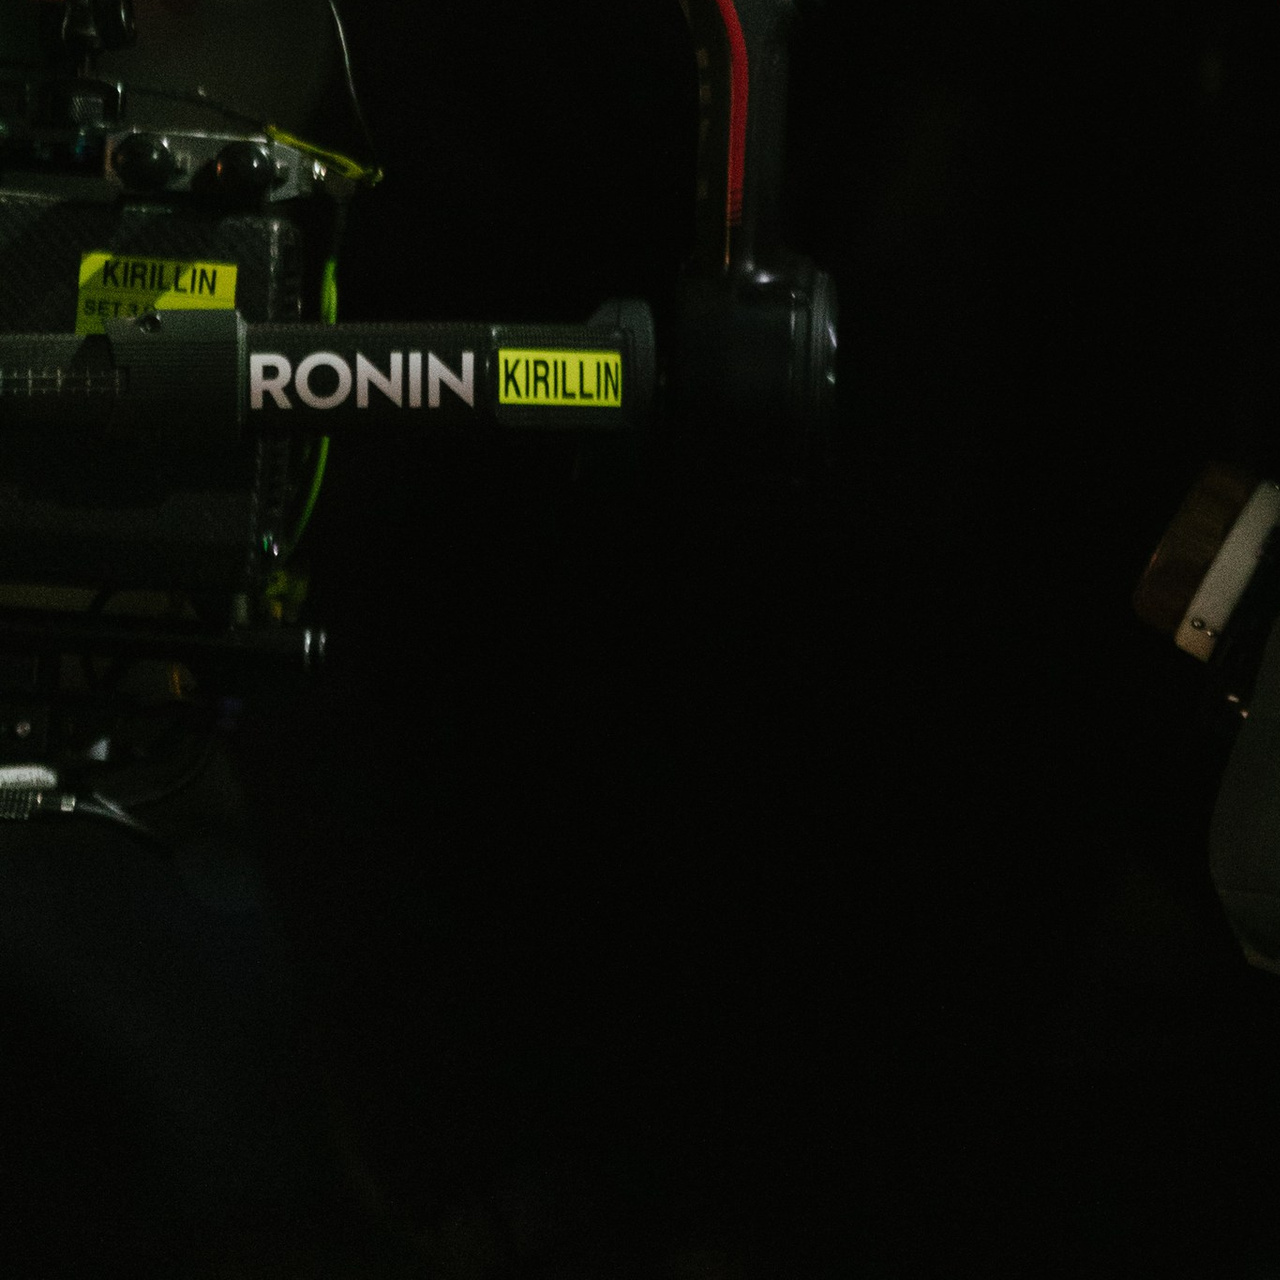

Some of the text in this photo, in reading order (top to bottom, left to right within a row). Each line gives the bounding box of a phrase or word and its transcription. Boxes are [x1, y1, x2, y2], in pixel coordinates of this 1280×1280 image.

[102, 260, 217, 296] KIRILLIN
[249, 351, 475, 409] RONIN
[503, 358, 620, 400] KIRILLIN
